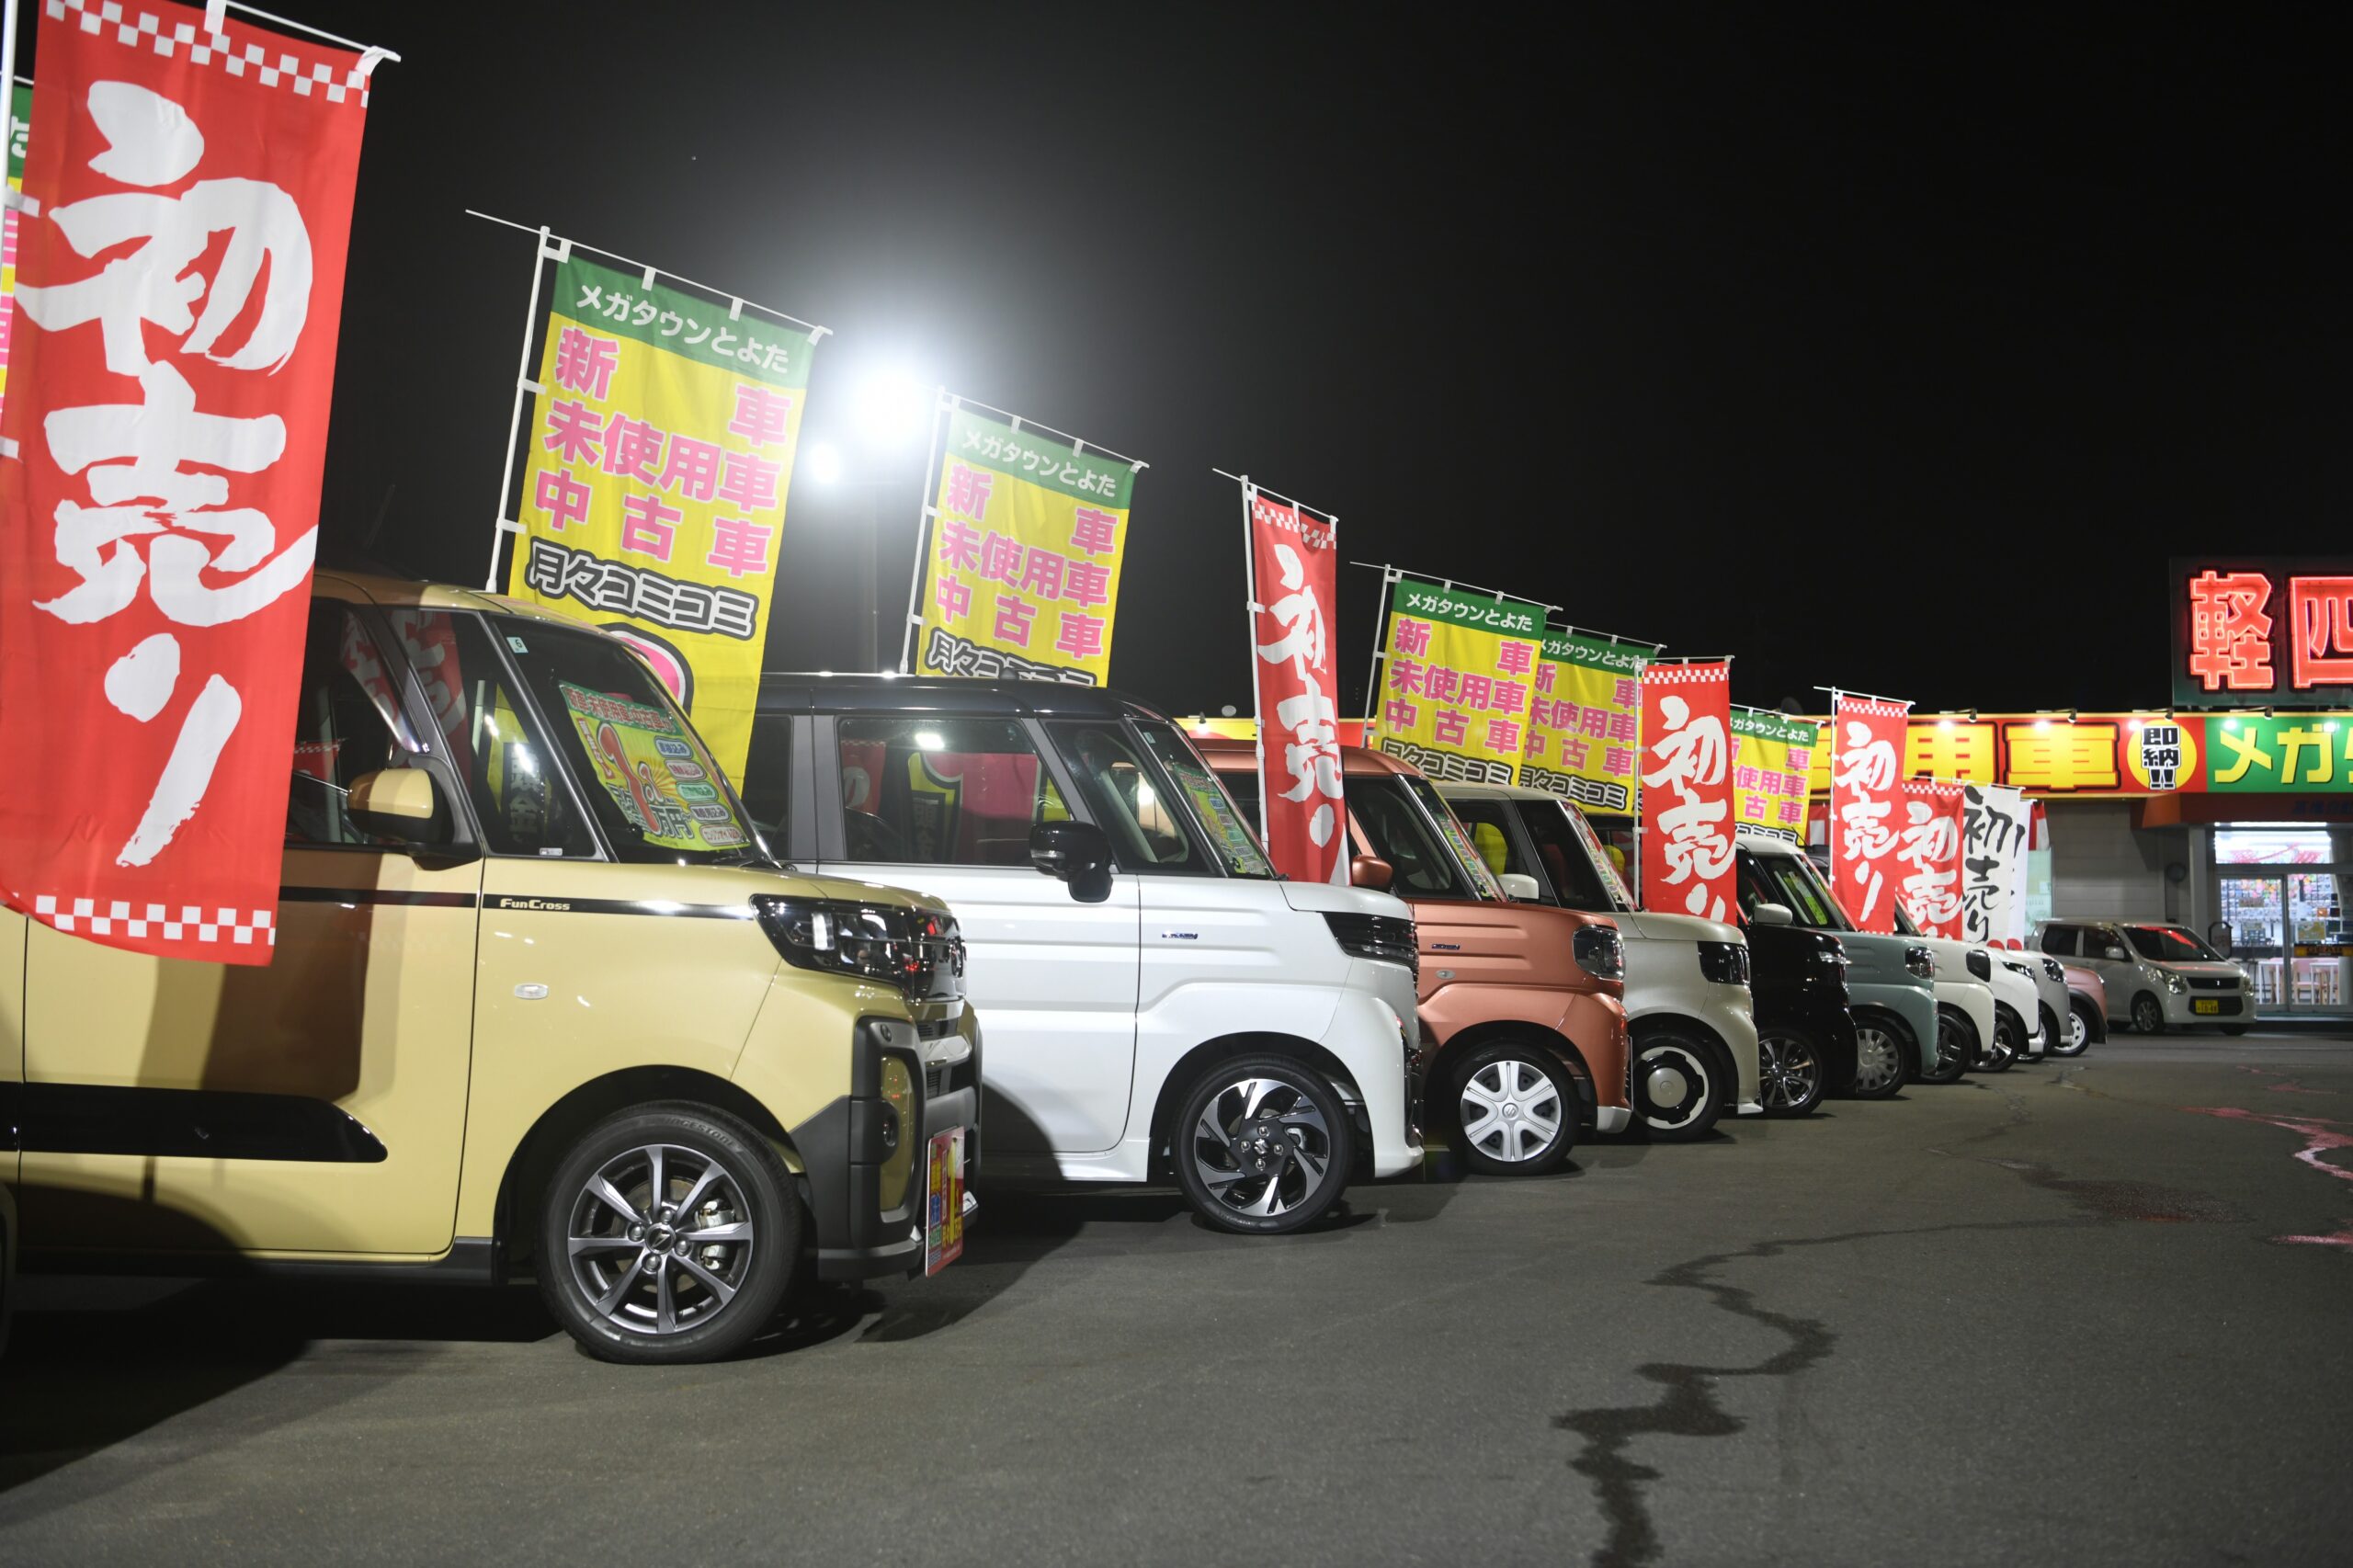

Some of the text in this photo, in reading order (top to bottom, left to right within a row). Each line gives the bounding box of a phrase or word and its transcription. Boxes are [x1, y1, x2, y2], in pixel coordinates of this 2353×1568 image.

[576, 285, 790, 374] メガタウンとよた
[14, 80, 318, 867] 初売り
[544, 399, 781, 514] 未使用車
[962, 430, 1117, 497] メガタウンとよた
[527, 538, 758, 640] 月々コミコミ
[939, 521, 1110, 608] 未使用車
[1406, 594, 1532, 631] メガタウンとよた
[1389, 659, 1527, 715] 未使用車
[1731, 719, 1809, 742] ガタウンとよた
[2214, 723, 2353, 783] メガ
[1733, 765, 1807, 798] 使用車
[1835, 721, 1899, 923] 初売り
[500, 898, 571, 911] FunCross
